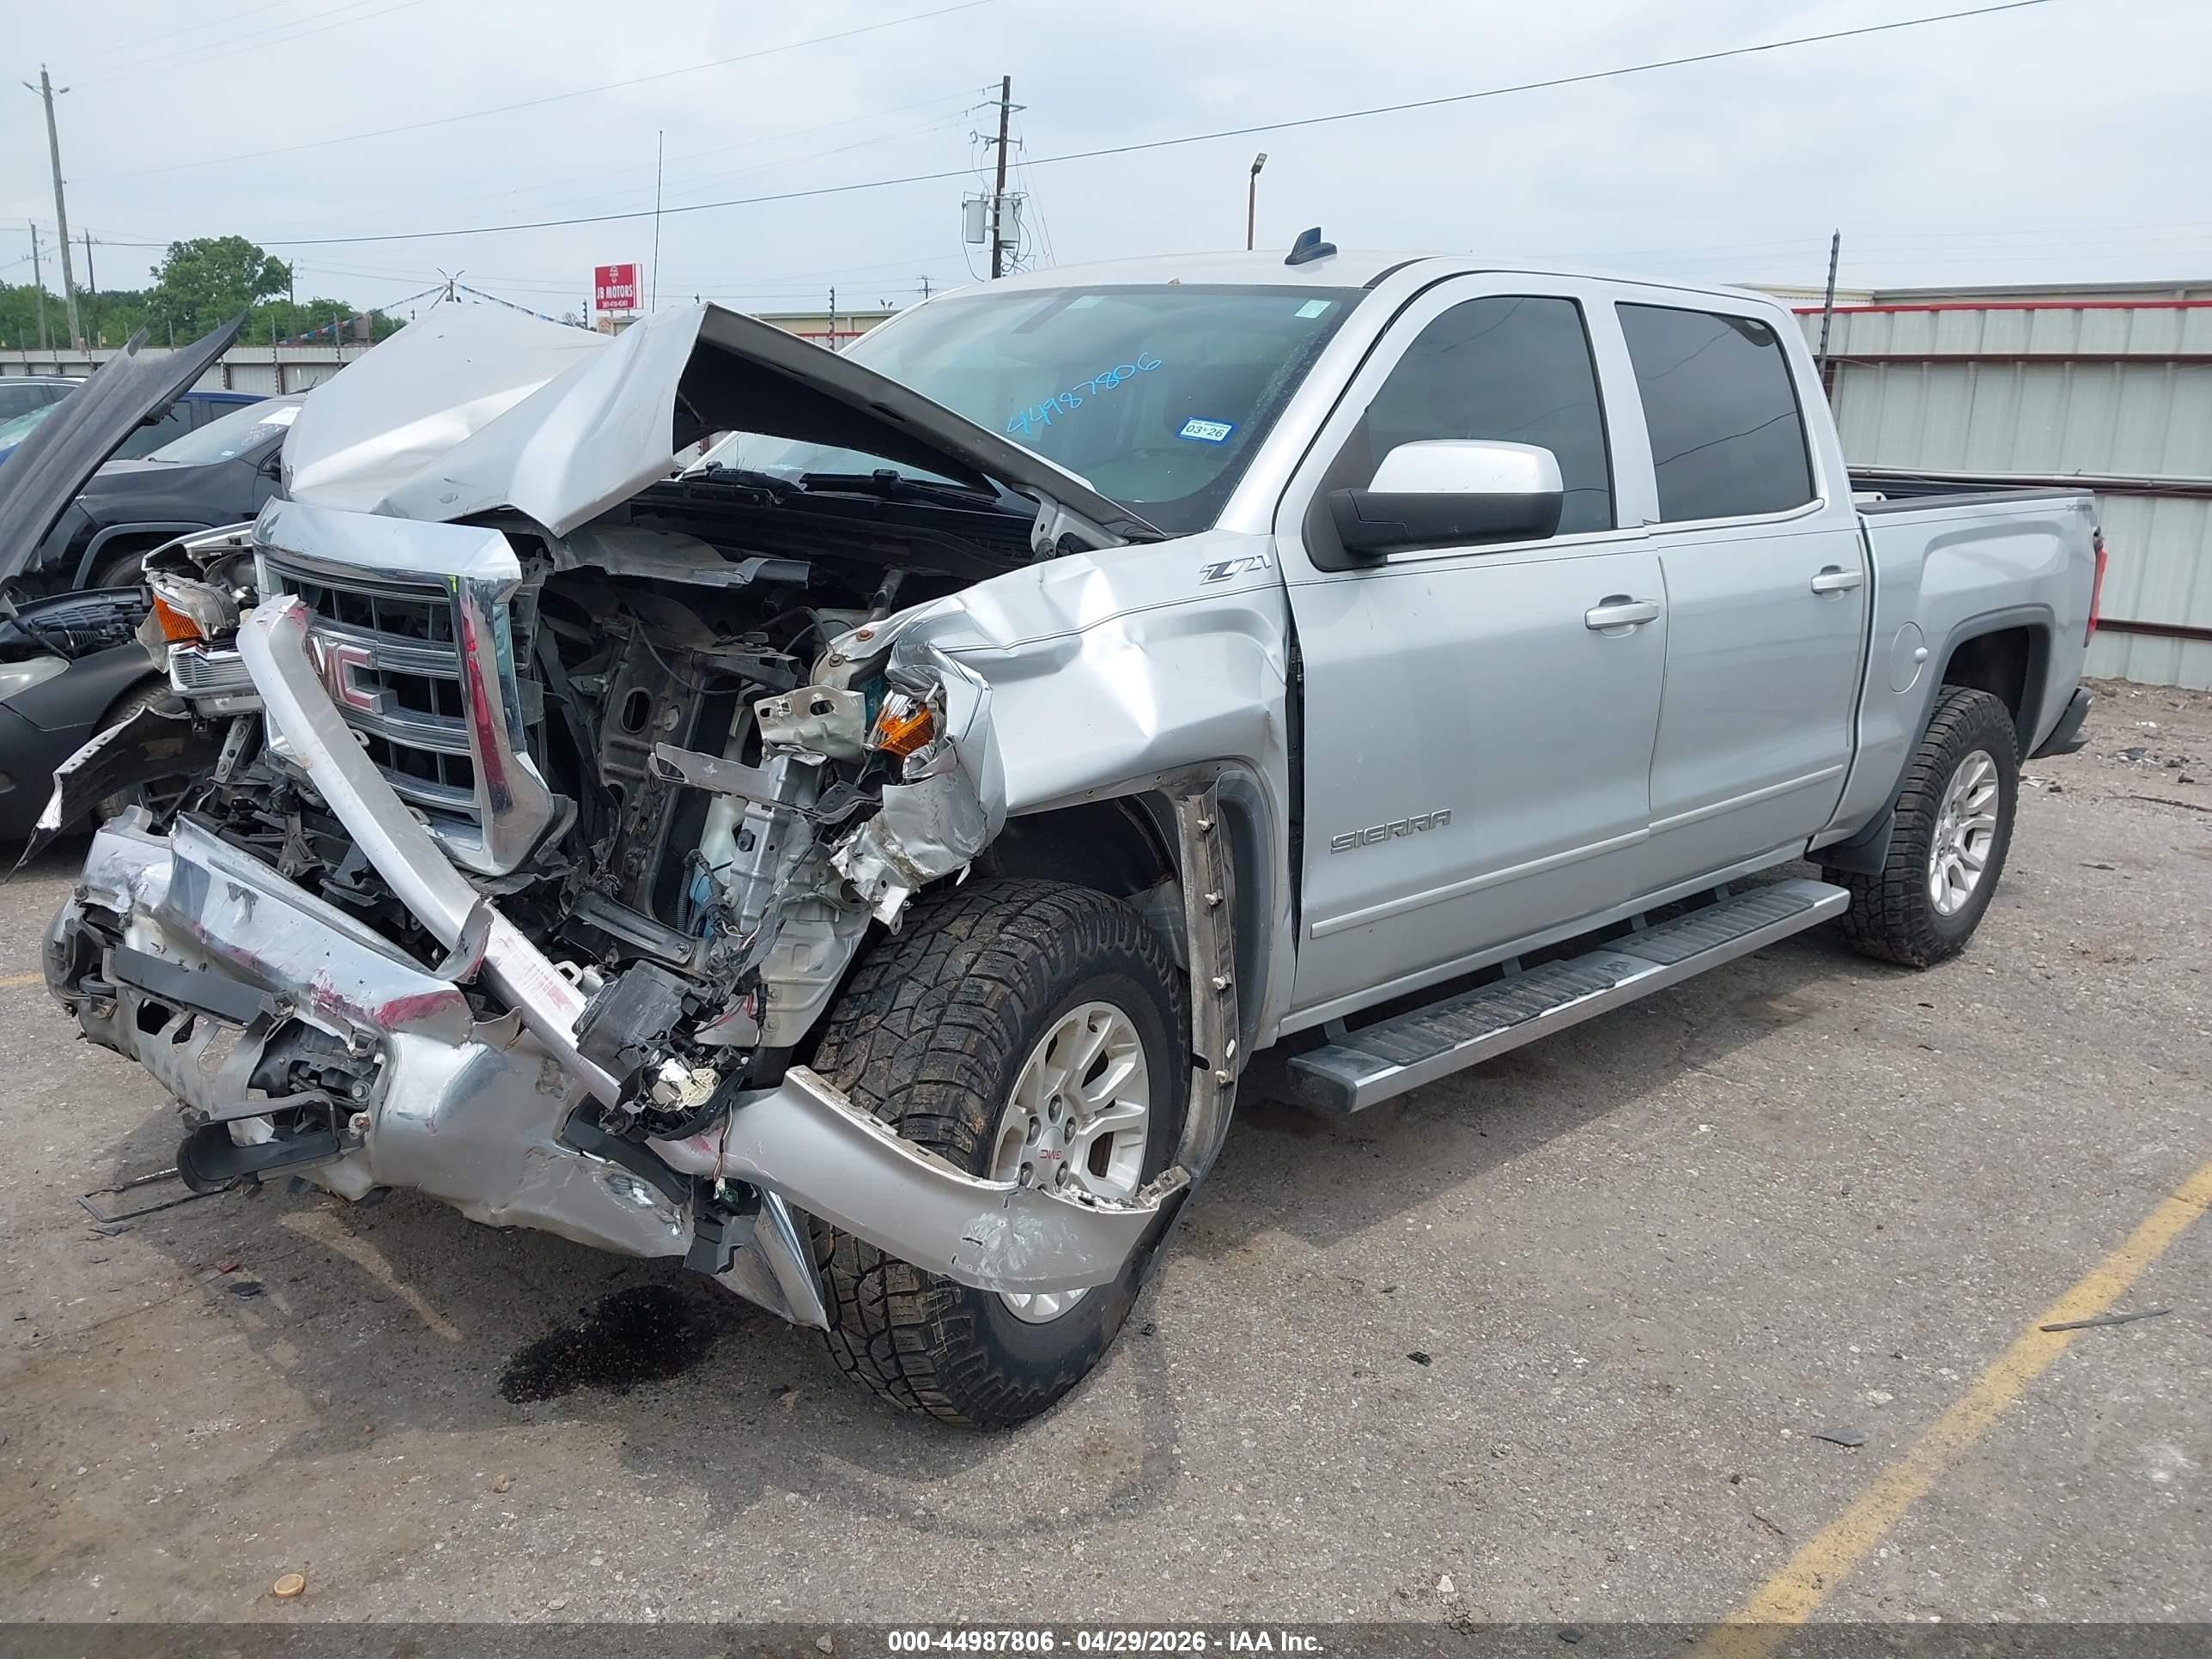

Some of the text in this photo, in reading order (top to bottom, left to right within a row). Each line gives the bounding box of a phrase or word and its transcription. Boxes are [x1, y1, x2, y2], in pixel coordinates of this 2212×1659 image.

[597, 283, 633, 300] JB MOTORS
[1006, 351, 1162, 435] 44987806
[1185, 424, 1203, 434] 03
[1206, 428, 1225, 438] 26
[1199, 554, 1273, 586] Z71
[304, 634, 385, 714] MC
[1330, 808, 1452, 854] SIERRA
[1039, 1149, 1062, 1160] GMC
